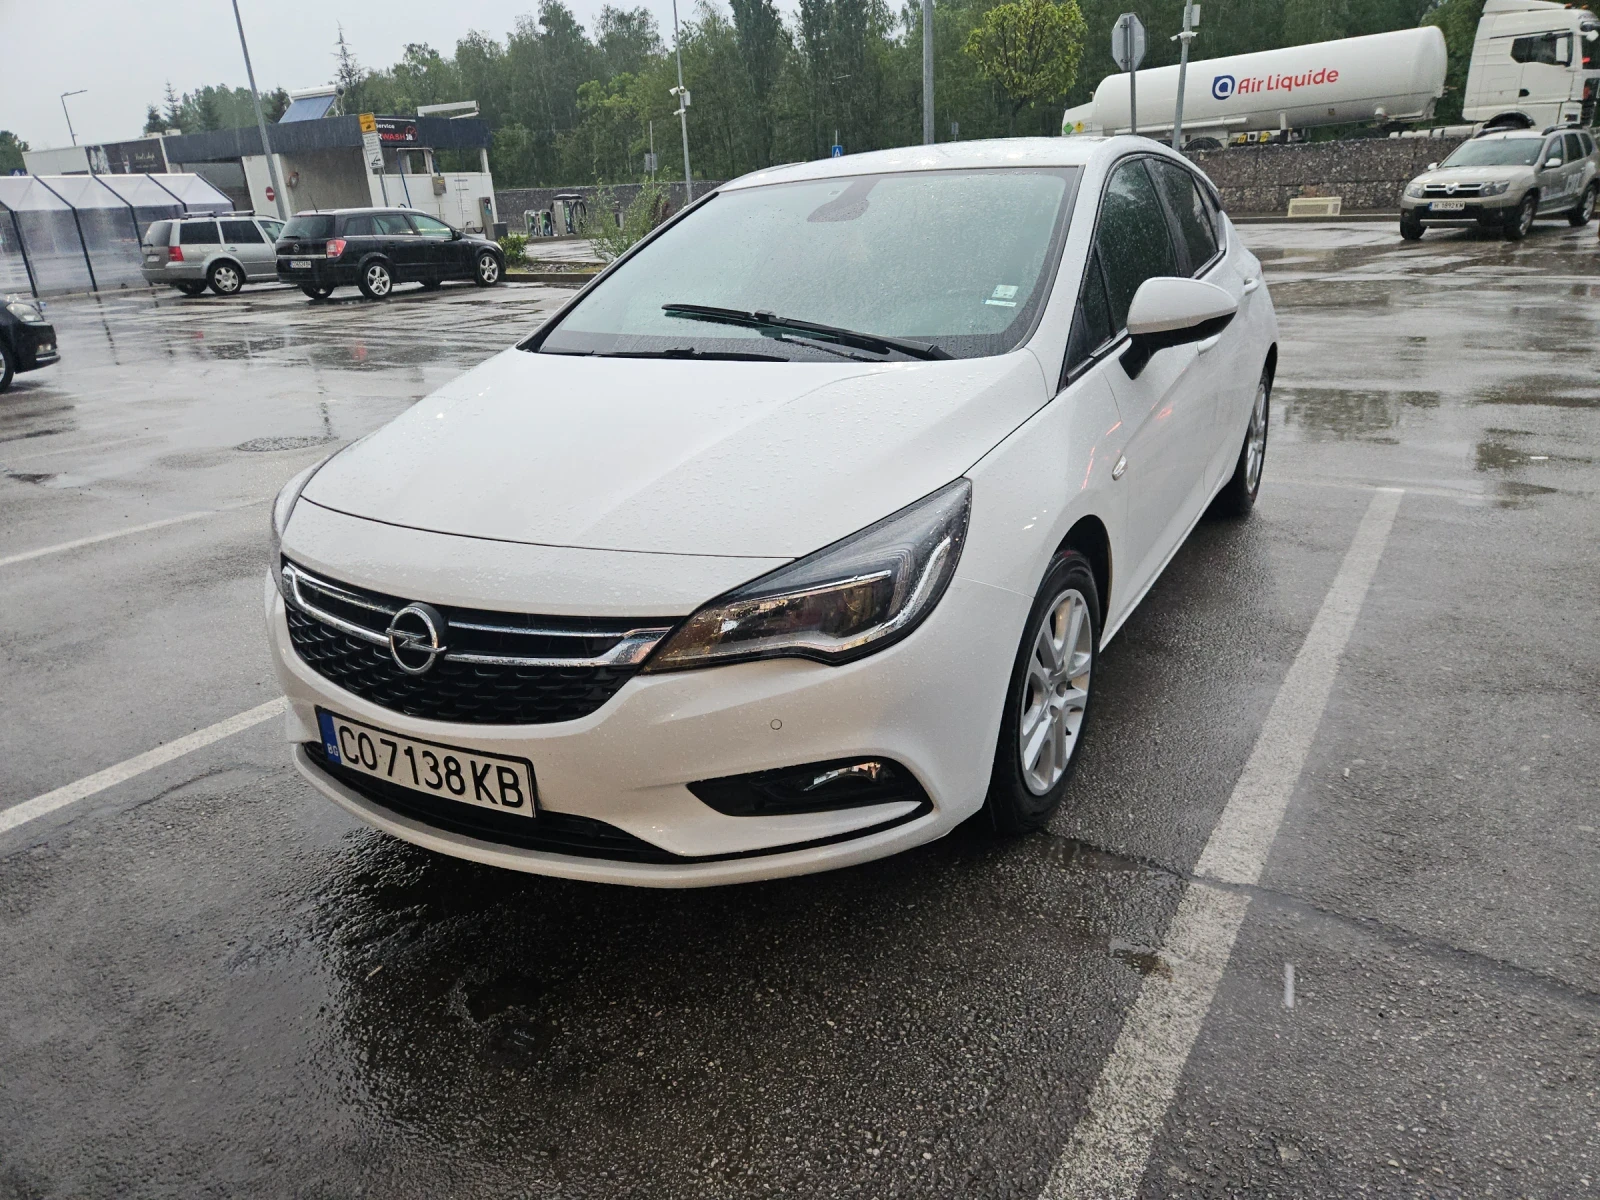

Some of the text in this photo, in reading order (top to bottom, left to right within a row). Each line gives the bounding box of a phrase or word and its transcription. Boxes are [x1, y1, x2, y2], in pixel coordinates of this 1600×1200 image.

[1237, 68, 1339, 95] Air Liquide
[327, 742, 339, 757] BG
